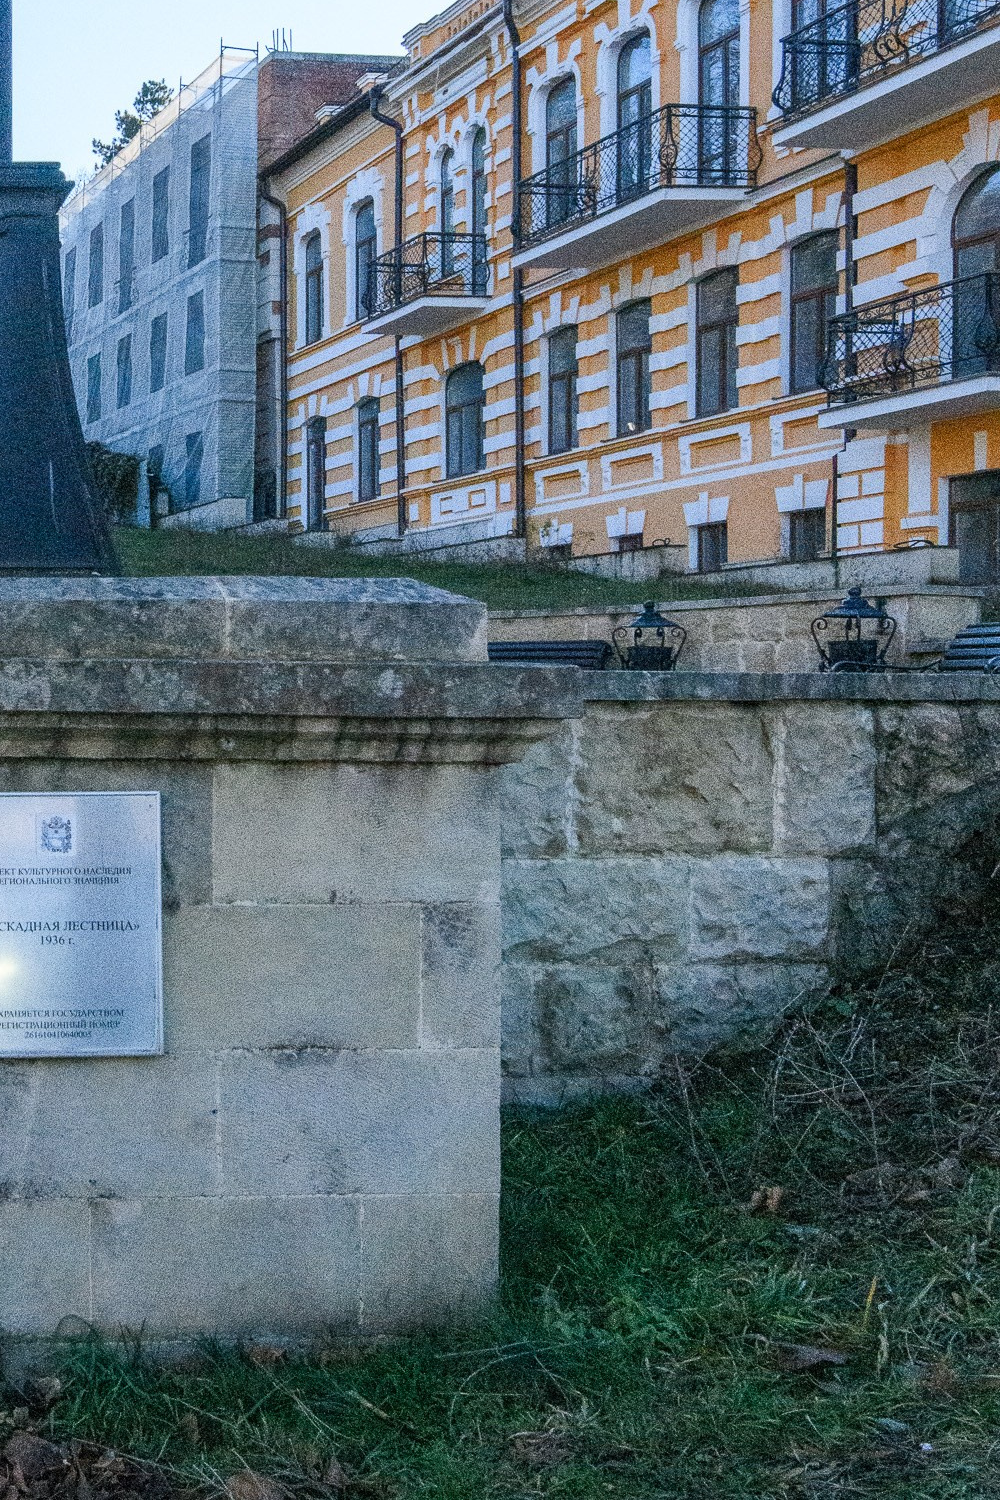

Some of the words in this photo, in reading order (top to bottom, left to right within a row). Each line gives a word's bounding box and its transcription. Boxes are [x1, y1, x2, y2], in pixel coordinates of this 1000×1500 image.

[17, 867, 82, 876] КУЛЬТУРНОГО
[83, 866, 132, 876] НАСЛЕДИЯ
[73, 876, 120, 885] ЗНАЧЕНИЯ
[63, 920, 140, 933] ЛЕСТНИЦА»
[40, 935, 65, 945] 1936
[52, 1009, 125, 1018] ГОСУДАРСТВОМ
[89, 1021, 121, 1029] НОМЕР
